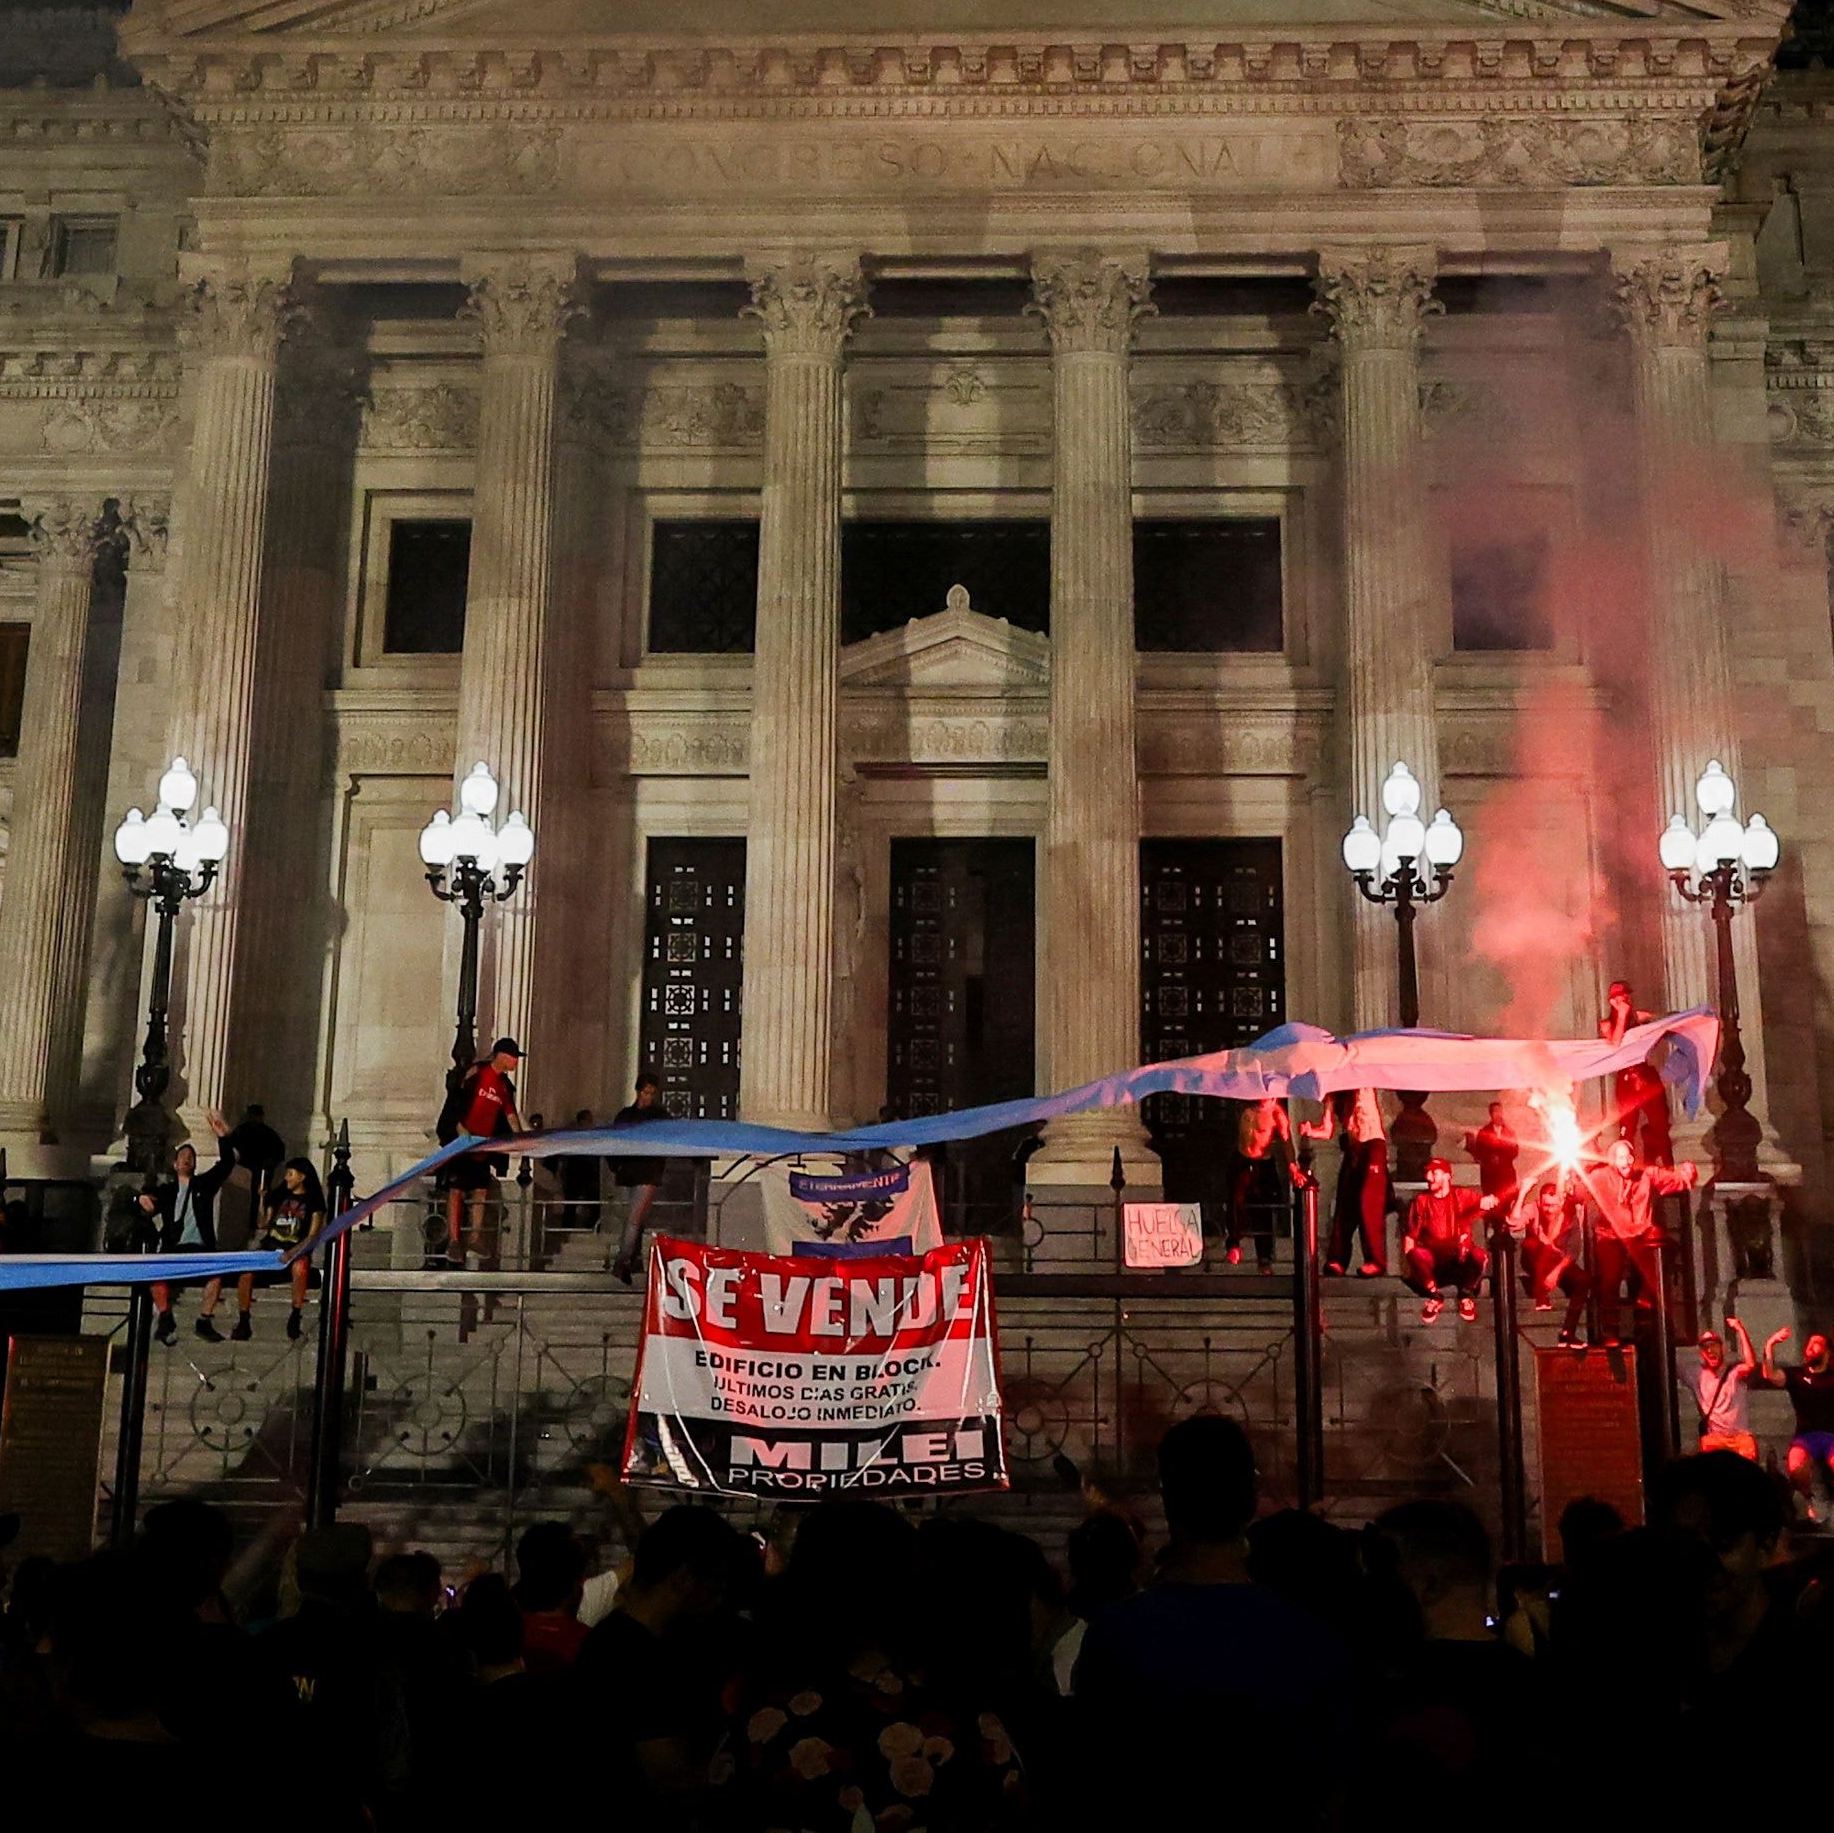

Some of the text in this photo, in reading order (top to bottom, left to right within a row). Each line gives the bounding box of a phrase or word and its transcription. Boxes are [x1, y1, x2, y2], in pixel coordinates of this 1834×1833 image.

[1127, 1236, 1200, 1262] GENERAL
[665, 1258, 974, 1337] SE VENDE
[695, 1350, 803, 1379] EDIFICIO
[812, 1364, 846, 1381] EN
[711, 1396, 922, 1421] DESALOJO INMEDIATO.
[729, 1429, 985, 1471] MILEI
